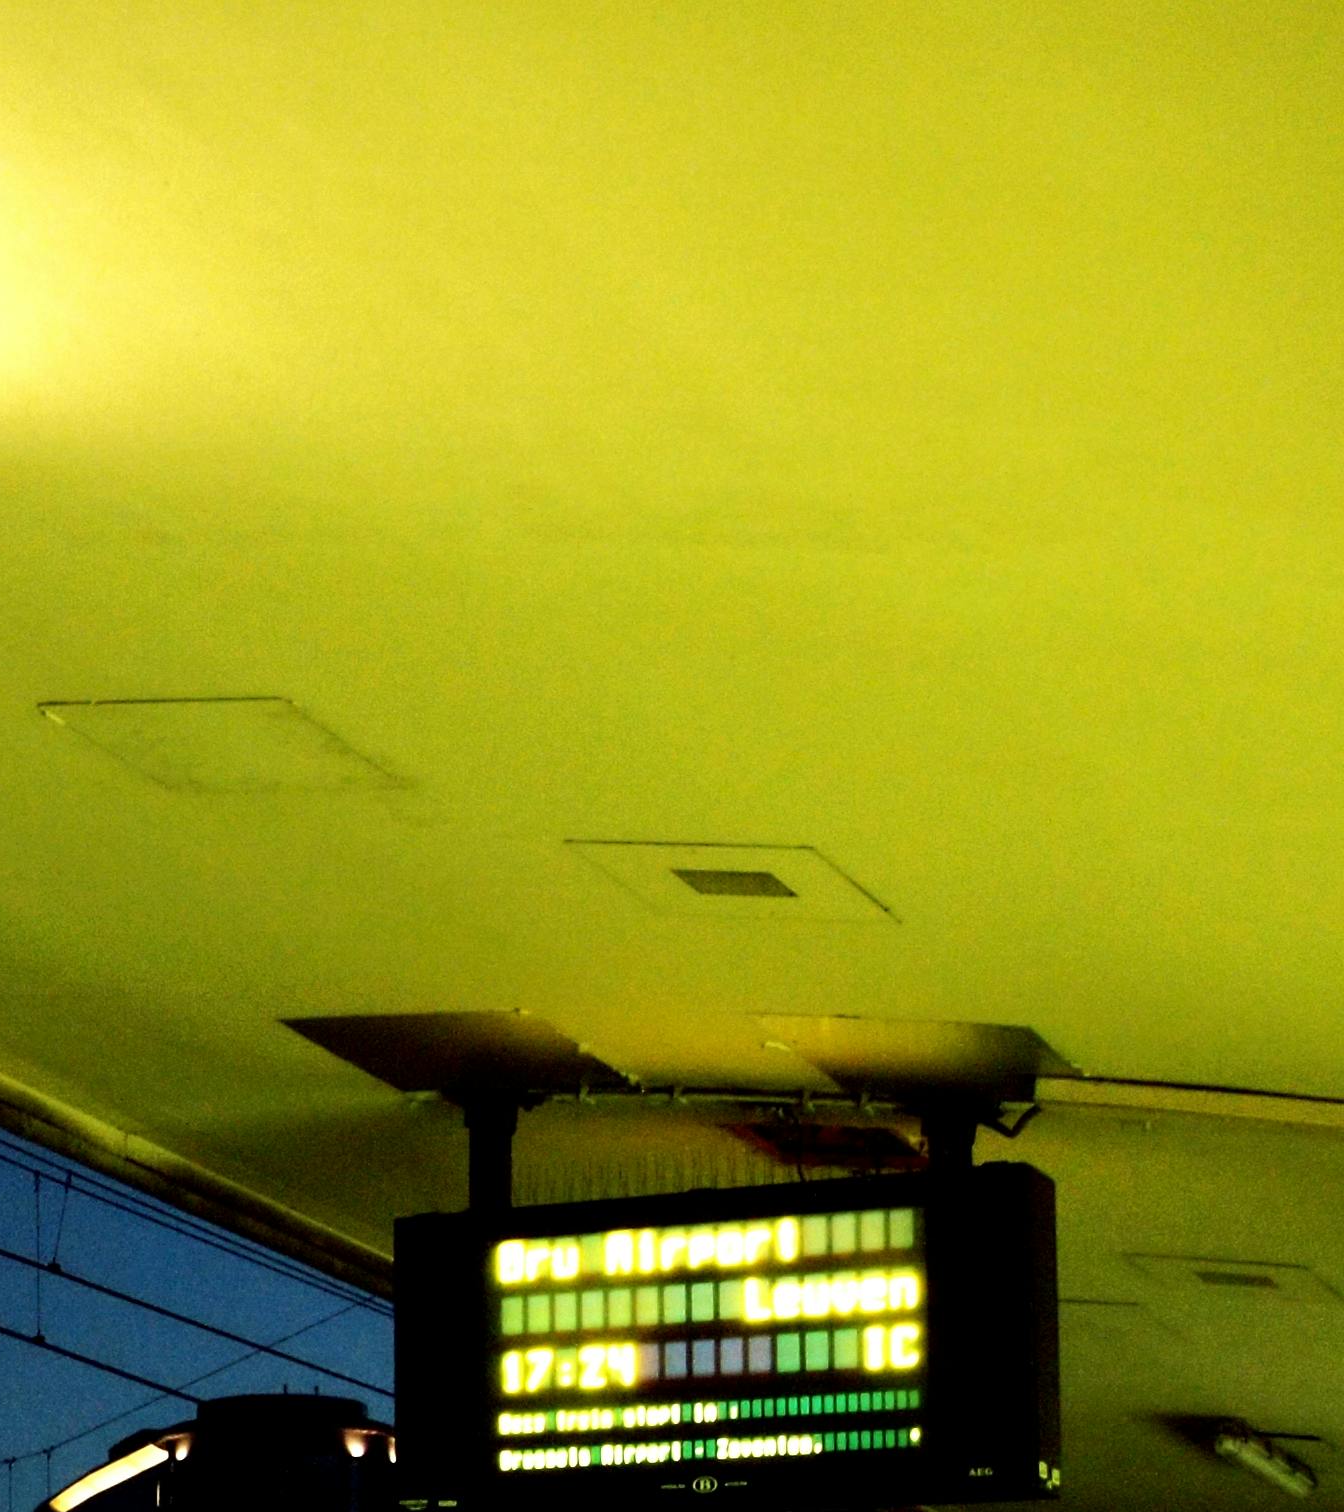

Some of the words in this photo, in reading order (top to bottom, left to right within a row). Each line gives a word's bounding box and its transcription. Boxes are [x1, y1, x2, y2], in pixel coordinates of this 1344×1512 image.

[603, 1216, 799, 1276] Airport
[742, 1270, 920, 1323] Leuven
[501, 1343, 638, 1395] 17:24
[862, 1322, 921, 1371] IC
